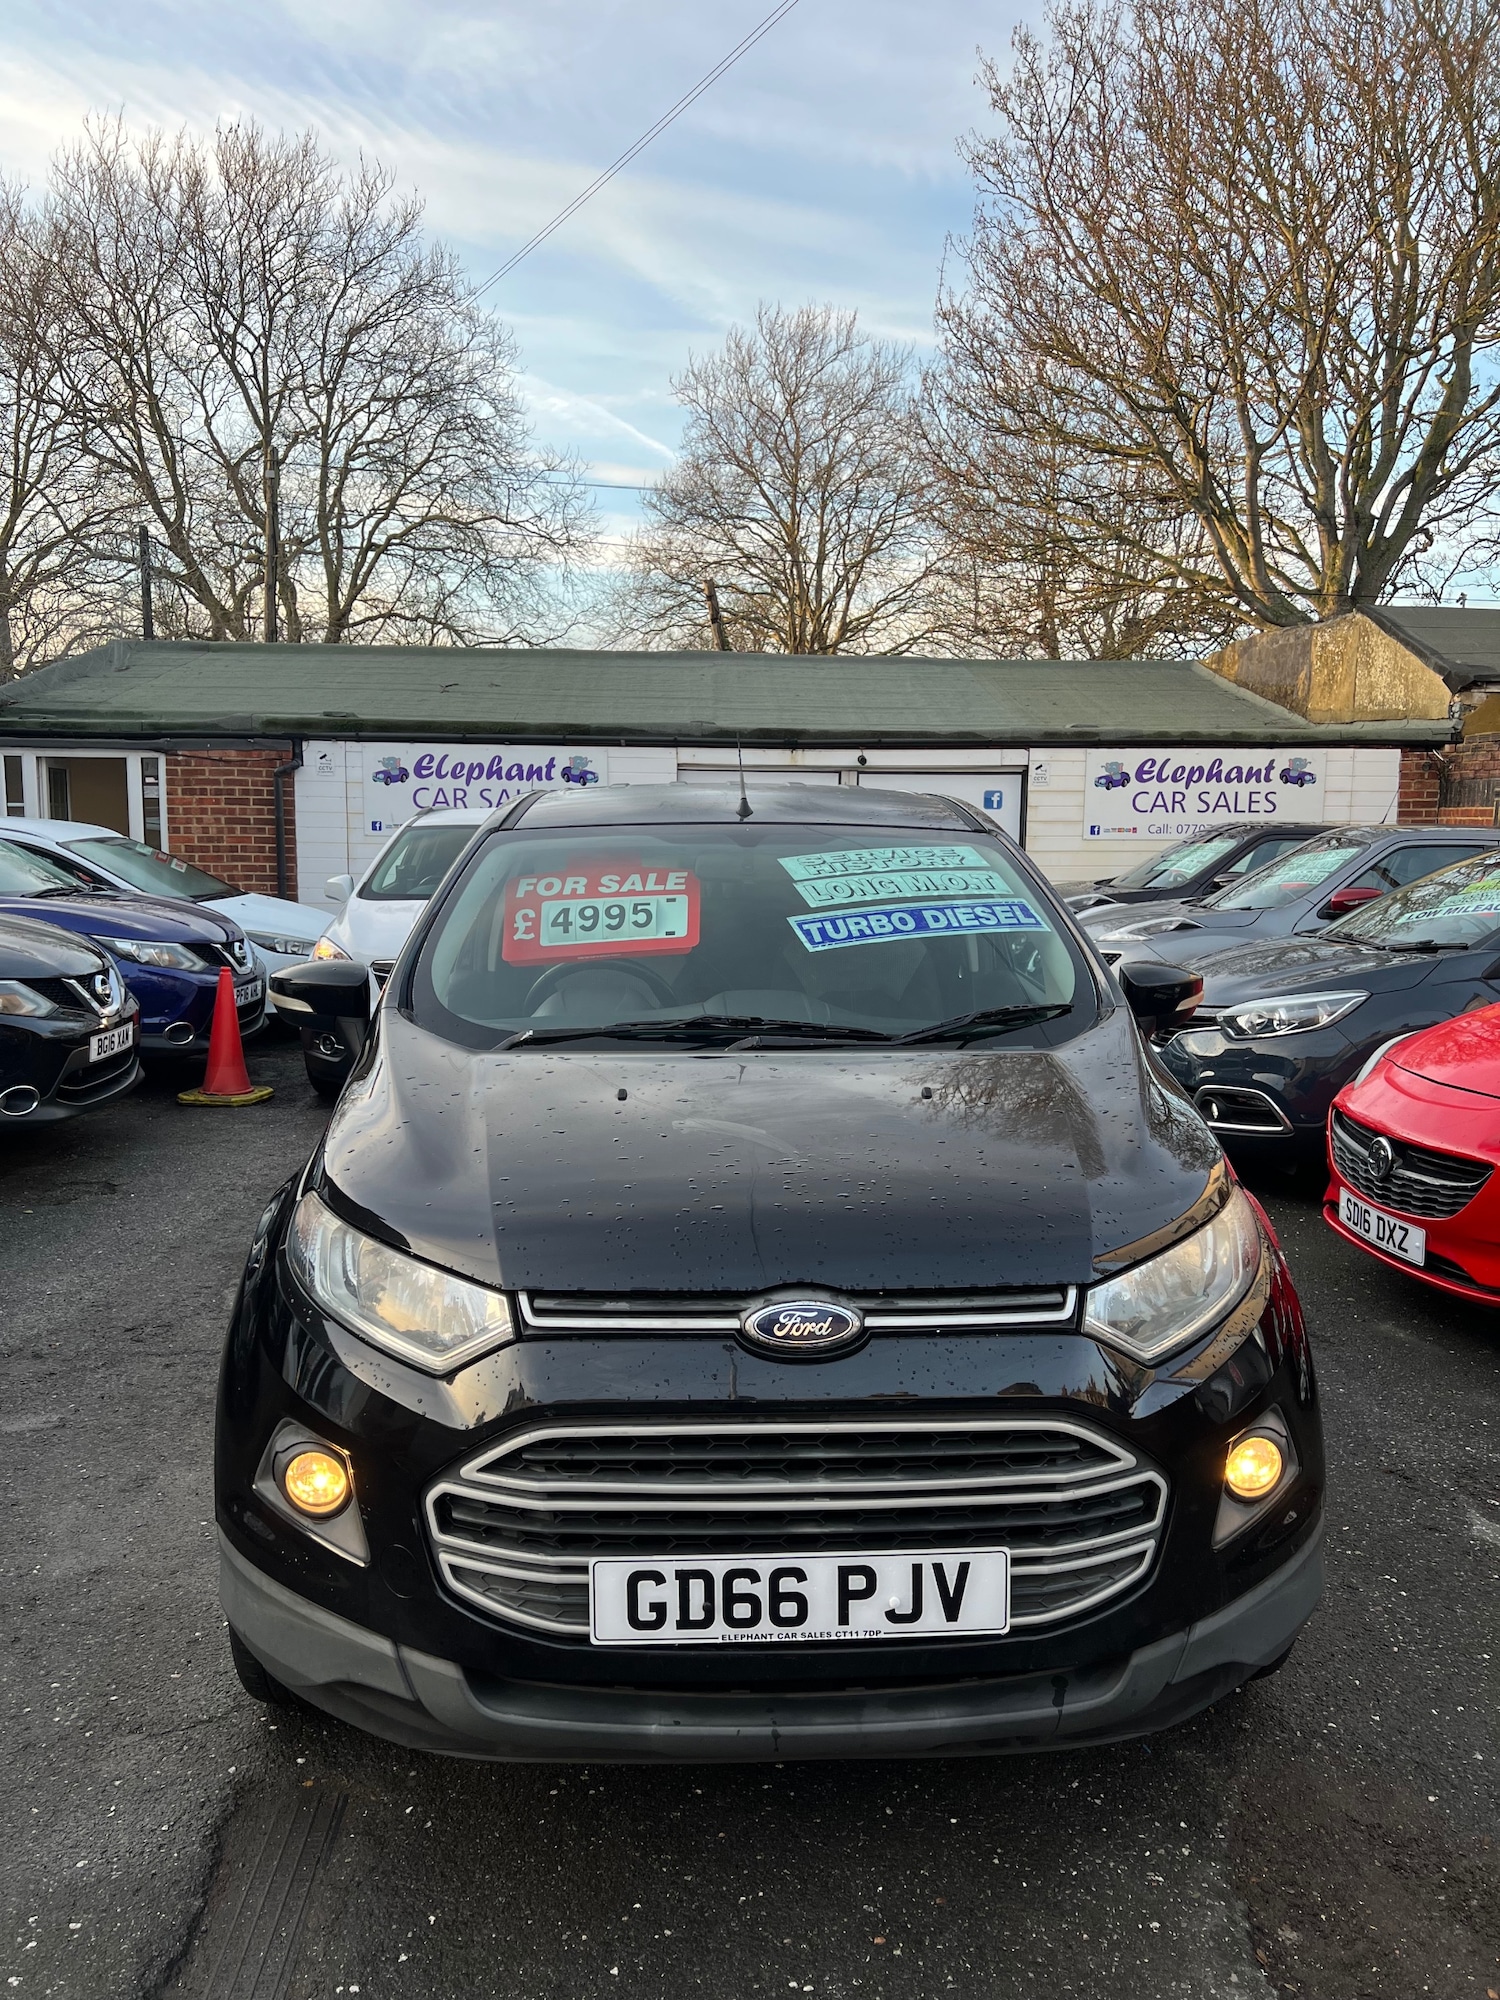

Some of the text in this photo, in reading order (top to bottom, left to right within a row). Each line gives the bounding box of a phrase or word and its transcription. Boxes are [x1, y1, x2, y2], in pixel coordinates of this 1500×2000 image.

[413, 753, 556, 787] Elephant
[1134, 758, 1276, 790] Elephant
[413, 787, 521, 809] CAR SA
[1132, 791, 1277, 814] CAR SALES
[1147, 823, 1172, 835] Call:
[797, 847, 961, 865] SERVICE
[804, 855, 966, 876] HISTORY
[515, 872, 689, 898] FOR SALE
[803, 873, 997, 901] LONG M.O.T
[513, 902, 653, 941] £ 4995
[802, 905, 1037, 943] TURBO DIESEL
[1406, 911, 1441, 920] LOW
[97, 1033, 115, 1056] BG16
[1346, 1197, 1371, 1234] SD16
[1376, 1215, 1409, 1254] DXZ
[773, 1311, 833, 1337] Ford
[626, 1561, 971, 1631] GD66 PJV
[721, 1629, 882, 1641] ELEPHANT CAR SALES CT11 7DP
